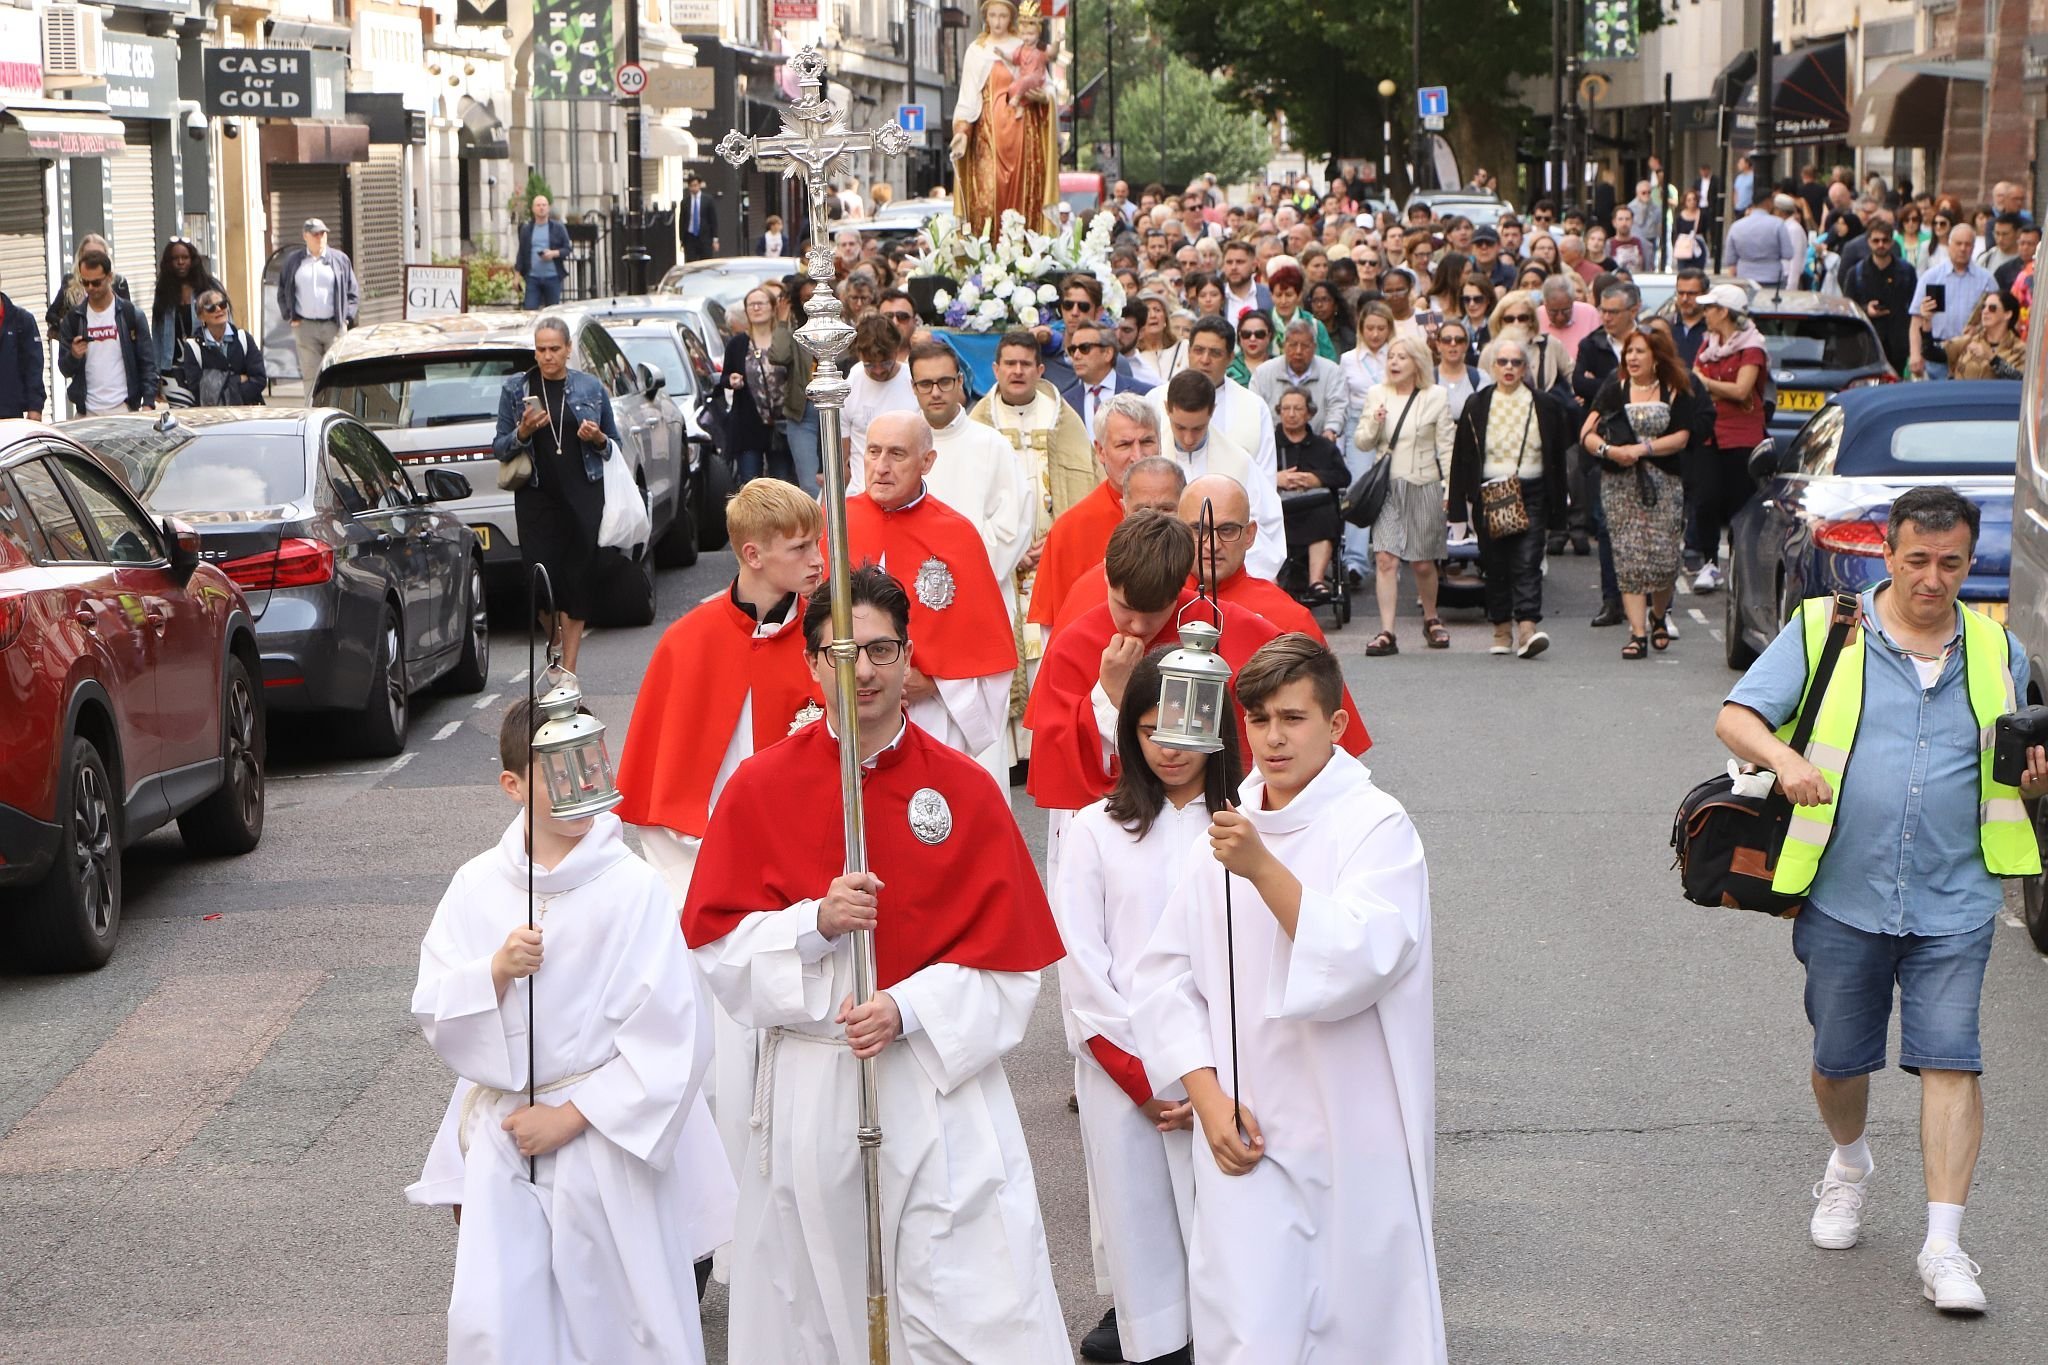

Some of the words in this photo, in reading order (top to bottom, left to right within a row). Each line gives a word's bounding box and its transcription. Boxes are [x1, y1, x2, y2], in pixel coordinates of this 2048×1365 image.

[219, 56, 299, 74] CASH
[244, 76, 274, 88] for
[621, 72, 642, 85] 20
[219, 90, 300, 108] GOLD
[408, 286, 459, 309] GIA
[1789, 391, 1818, 408] YTX
[396, 453, 484, 465] RSCHE
